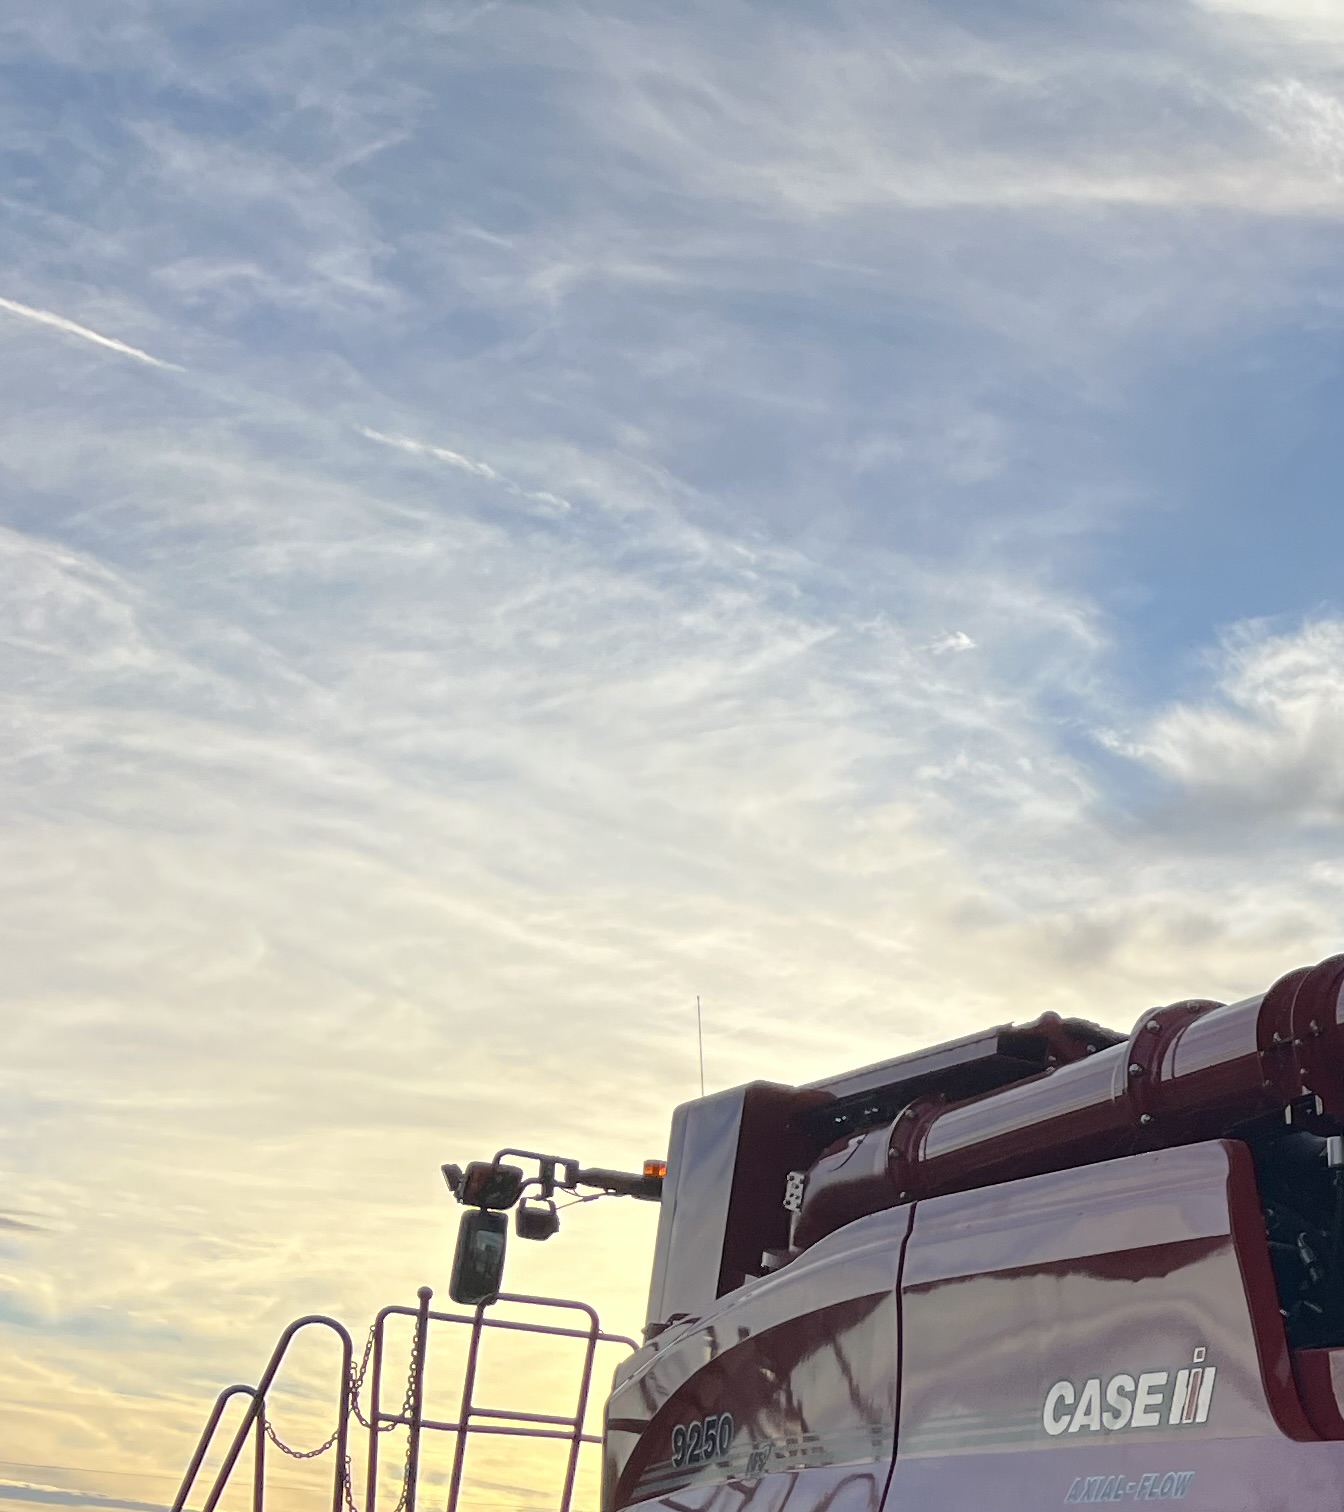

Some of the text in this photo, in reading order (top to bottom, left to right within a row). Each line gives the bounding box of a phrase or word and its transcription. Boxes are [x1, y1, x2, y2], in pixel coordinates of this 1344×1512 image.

[1043, 1372, 1168, 1435] CASE
[672, 1412, 734, 1467] 9250
[1064, 1471, 1195, 1503] AXIAL-FLOW
